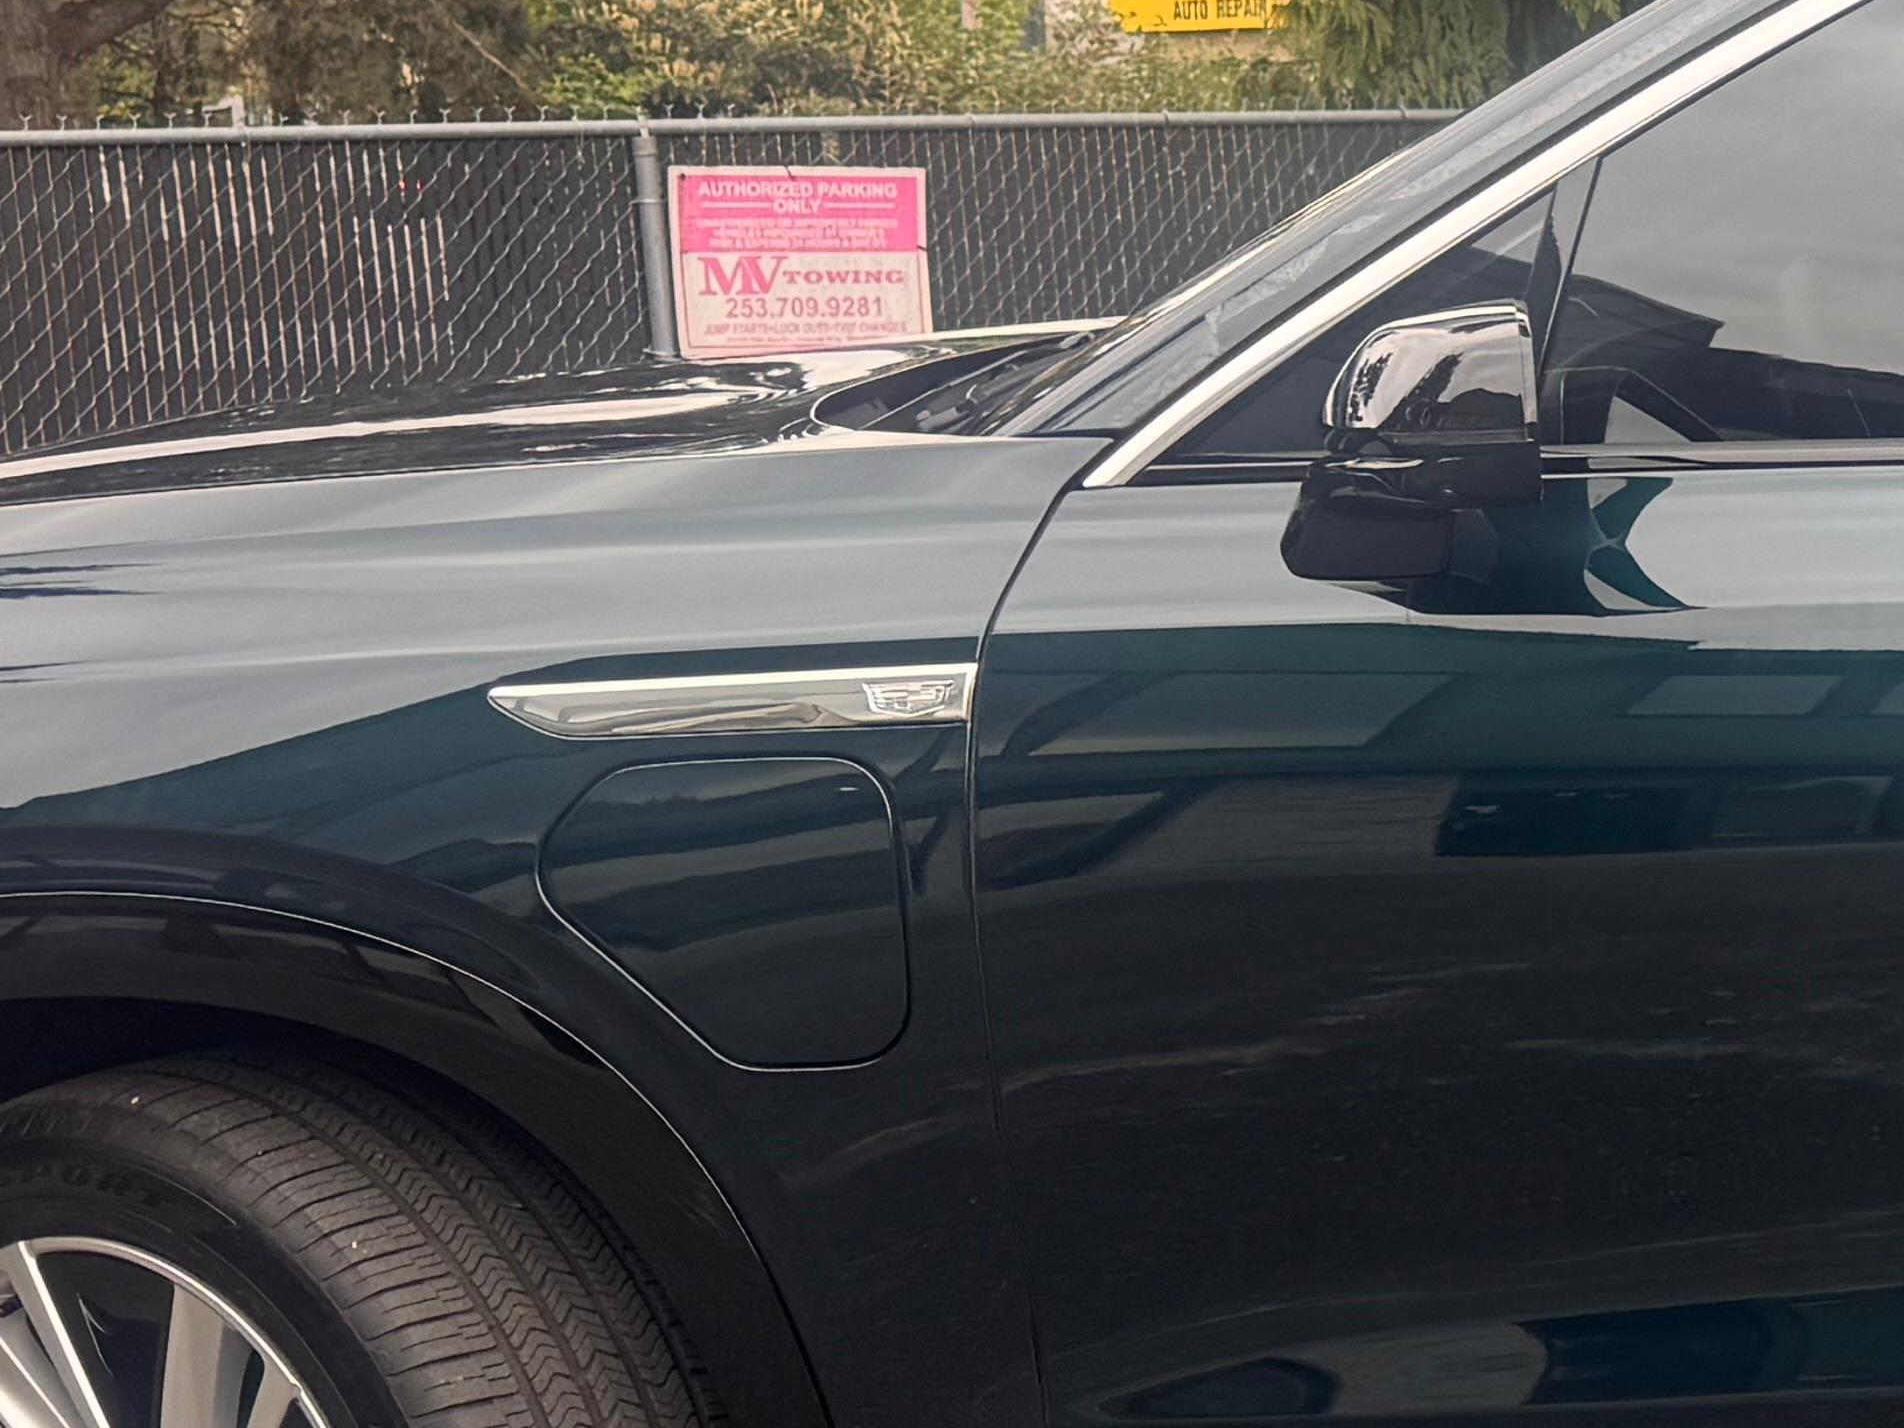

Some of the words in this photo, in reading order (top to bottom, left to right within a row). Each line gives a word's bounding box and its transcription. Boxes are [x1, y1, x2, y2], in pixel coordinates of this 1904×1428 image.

[1173, 0, 1208, 21] AUTO
[699, 181, 814, 198] AUTHORIZED
[817, 182, 898, 198] PARKING
[772, 198, 823, 214] ONLY
[697, 256, 789, 296] MV
[782, 270, 905, 285] TOWING
[726, 297, 883, 319] 253.709.9281
